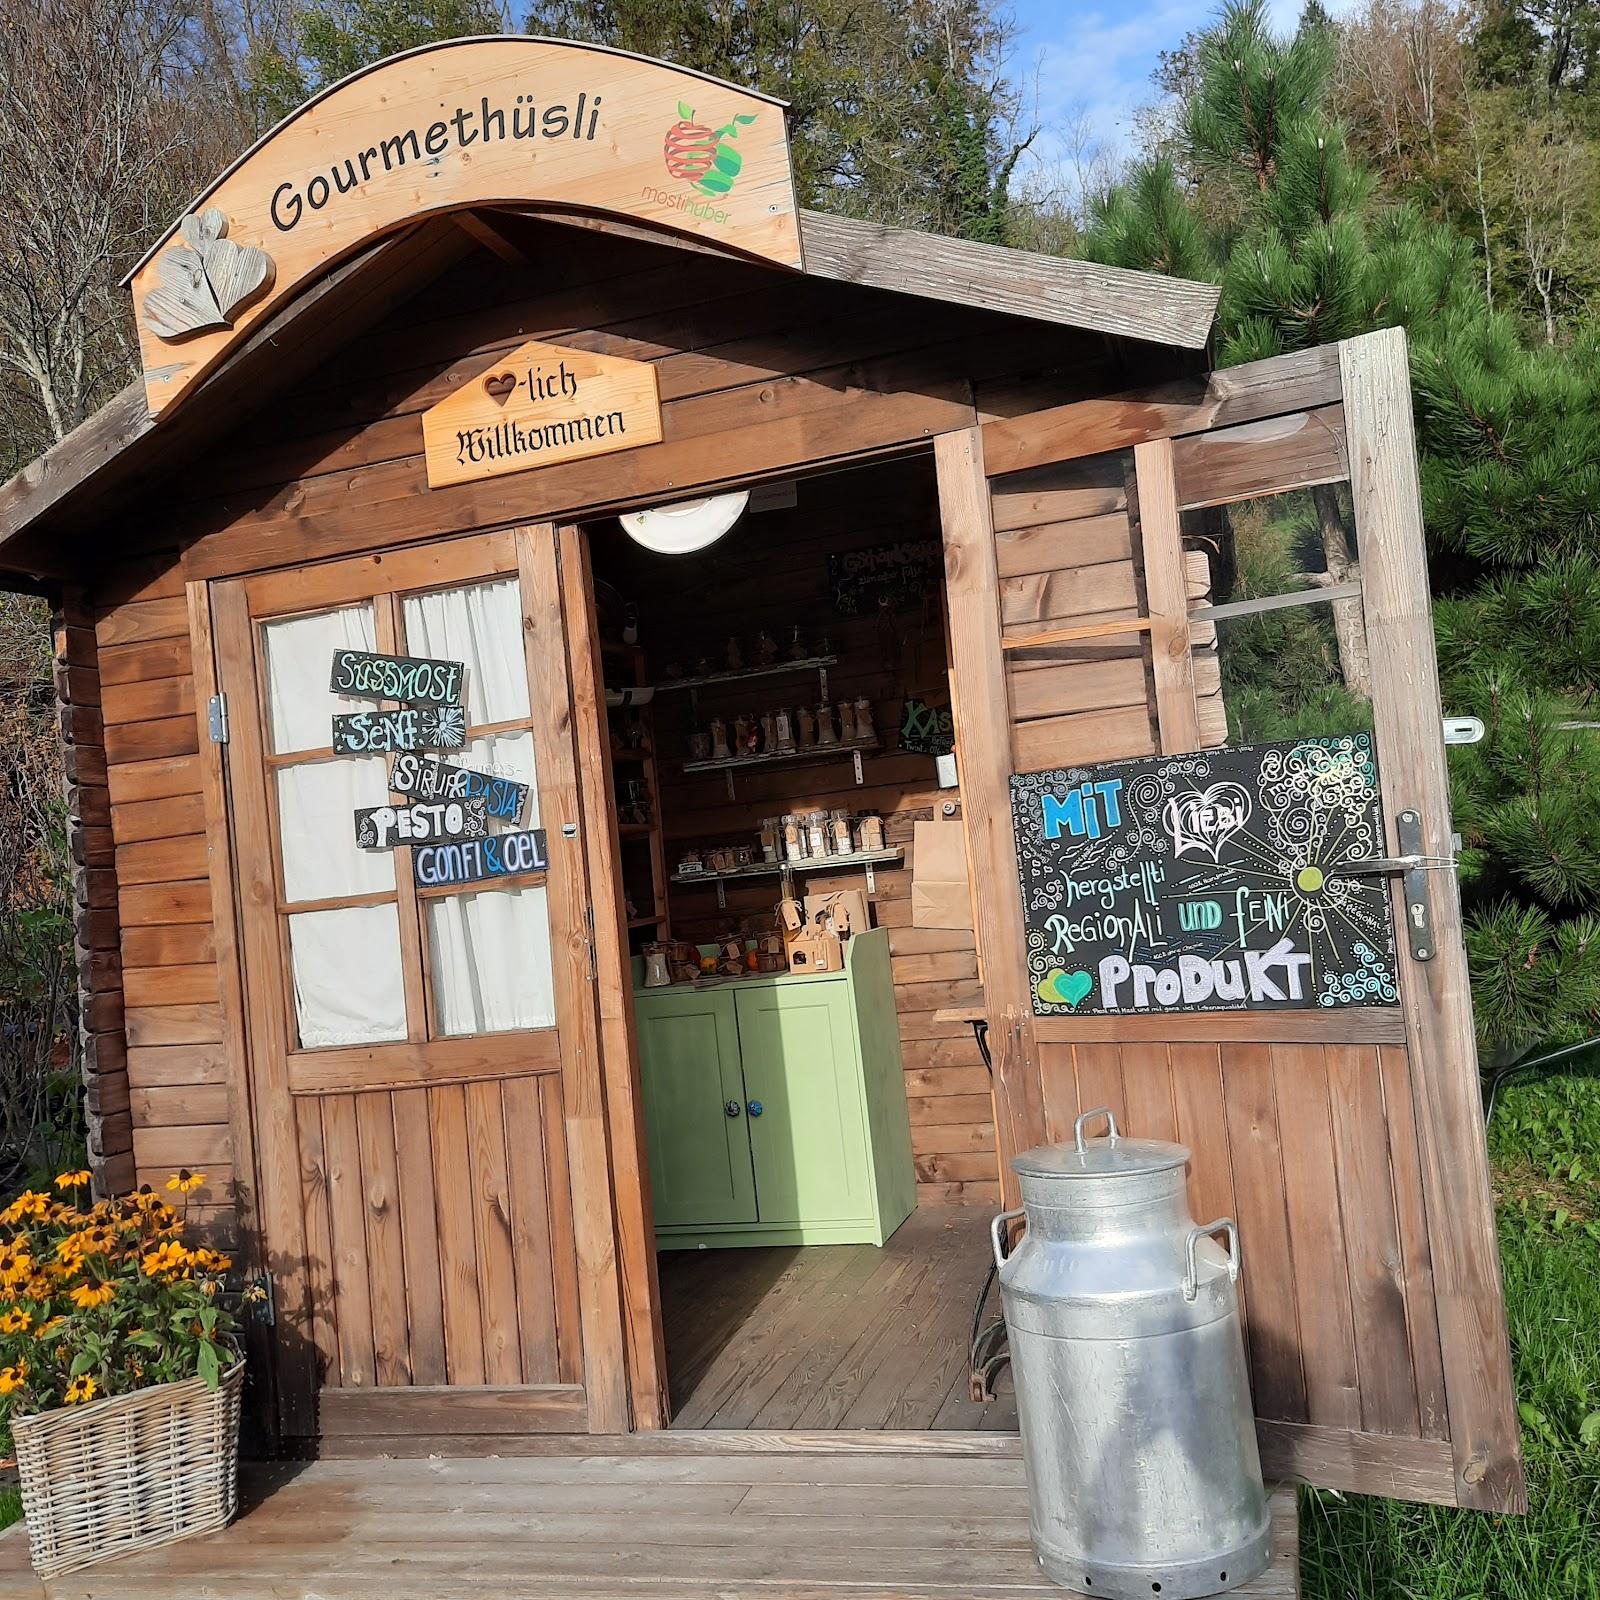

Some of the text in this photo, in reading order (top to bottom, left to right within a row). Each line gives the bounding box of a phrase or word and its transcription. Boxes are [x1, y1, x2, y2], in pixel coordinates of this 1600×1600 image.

[270, 92, 602, 231] Gourmethüsli
[641, 185, 732, 225] mostihuber
[456, 411, 626, 465] Willkommen
[368, 803, 464, 847] PESTO
[483, 837, 506, 873] &
